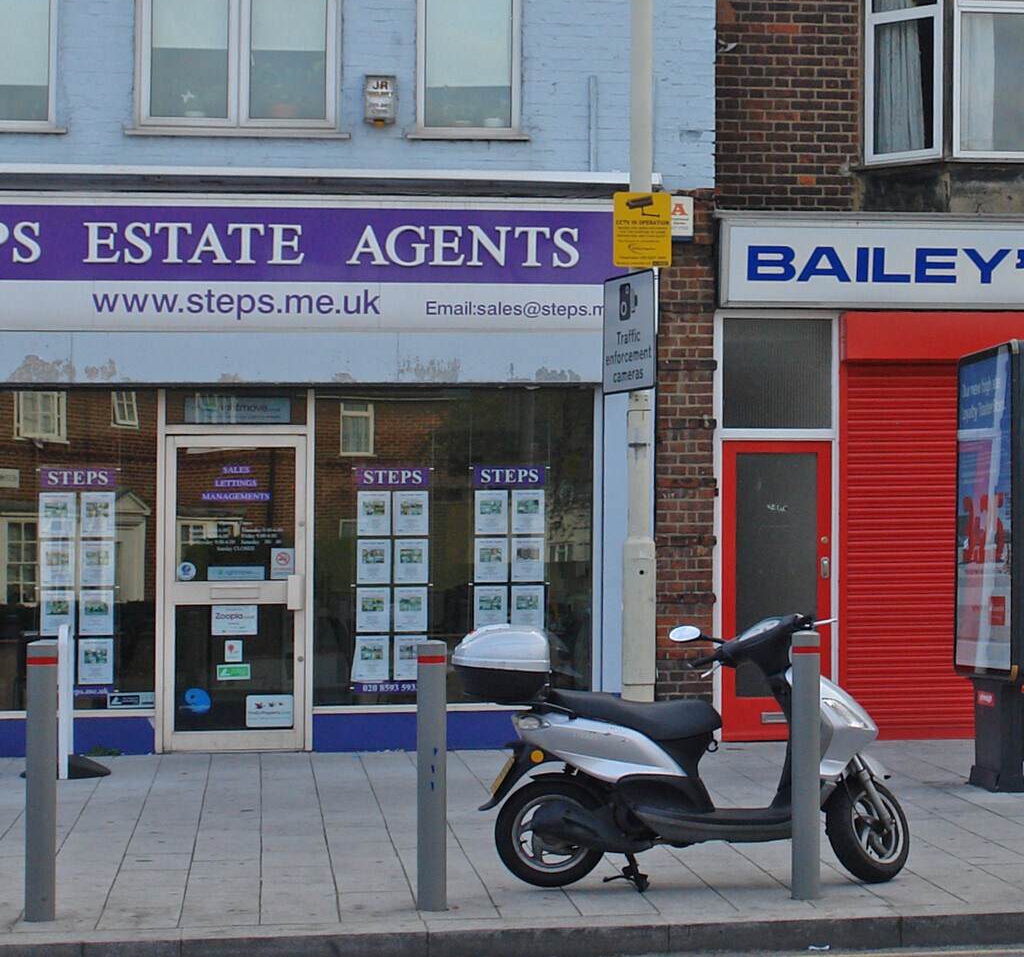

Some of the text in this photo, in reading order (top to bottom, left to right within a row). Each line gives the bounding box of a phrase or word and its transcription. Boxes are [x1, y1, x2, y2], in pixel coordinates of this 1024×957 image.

[373, 81, 388, 90] JR
[83, 222, 305, 266] ESTATE
[346, 224, 580, 269] AGENTS
[92, 289, 381, 321] www.steps.me.uk
[616, 329, 641, 345] Traffic
[605, 347, 652, 366] enforcement
[613, 368, 644, 384] cameras
[222, 466, 250, 474] SALES
[363, 470, 423, 485] STEPS
[480, 469, 539, 484] STEPS
[47, 470, 109, 486] STEPS
[214, 479, 258, 488] LETTINGS
[202, 492, 270, 501] MANAGEMENTS
[362, 683, 418, 692] 020 8593 593
